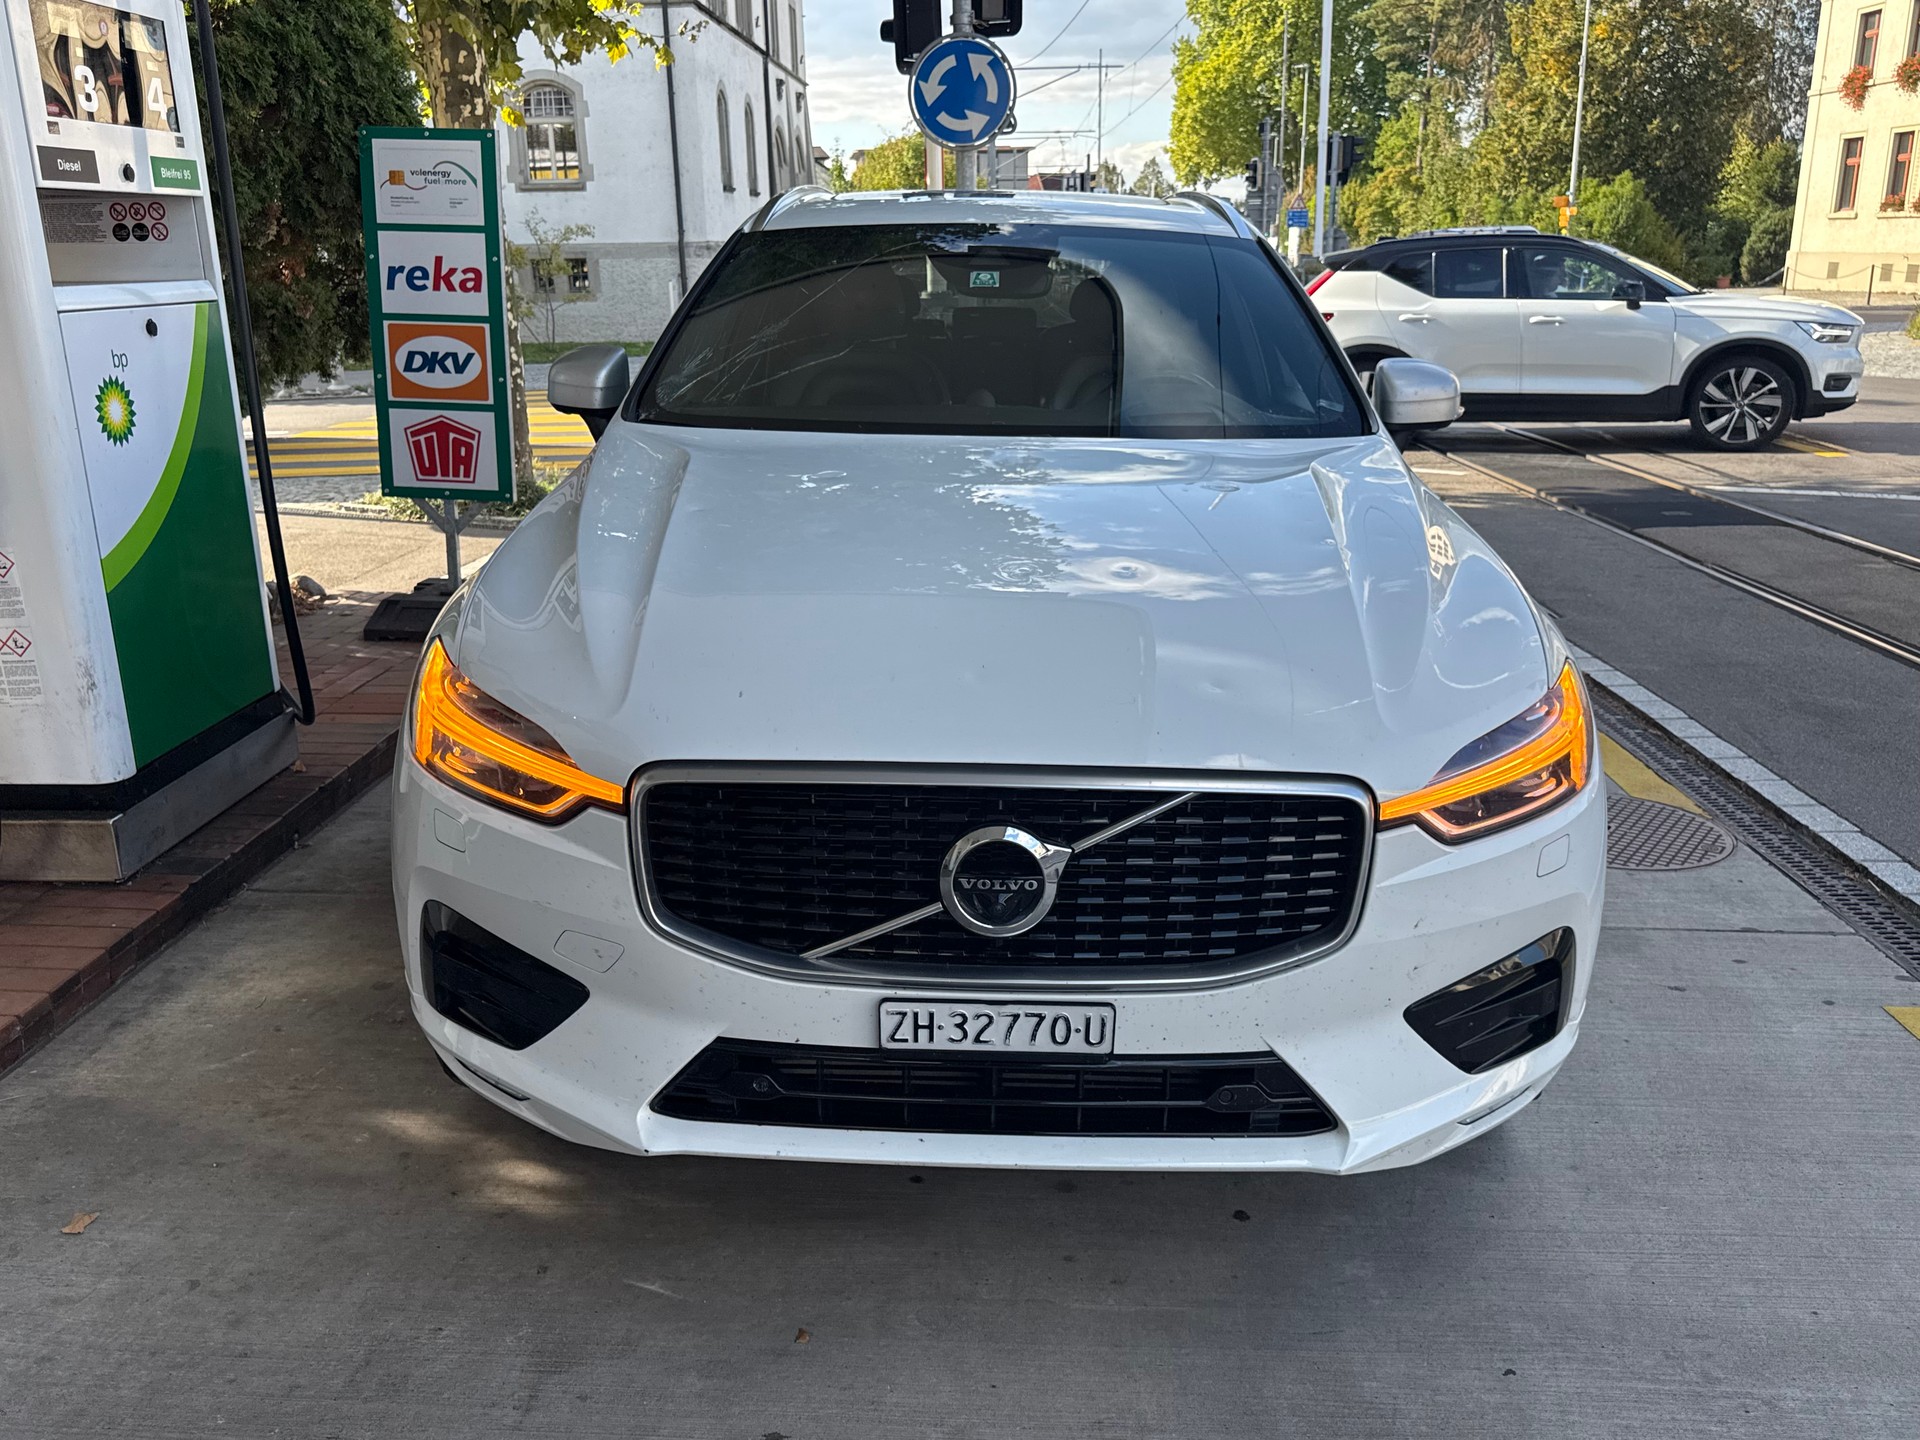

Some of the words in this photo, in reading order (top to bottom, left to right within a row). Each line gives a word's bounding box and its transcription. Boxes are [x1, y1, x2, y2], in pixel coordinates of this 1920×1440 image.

[74, 65, 98, 112] 3
[147, 77, 167, 120] 4
[57, 158, 81, 172] Diesel
[161, 167, 182, 179] Bleifrei
[183, 169, 192, 180] 95
[410, 168, 451, 178] volenergy
[424, 177, 440, 185] fuel
[386, 256, 483, 293] reka
[111, 349, 128, 372] bp
[403, 350, 475, 374] DKV
[408, 419, 476, 479] UTA
[958, 878, 1038, 890] VOLVO
